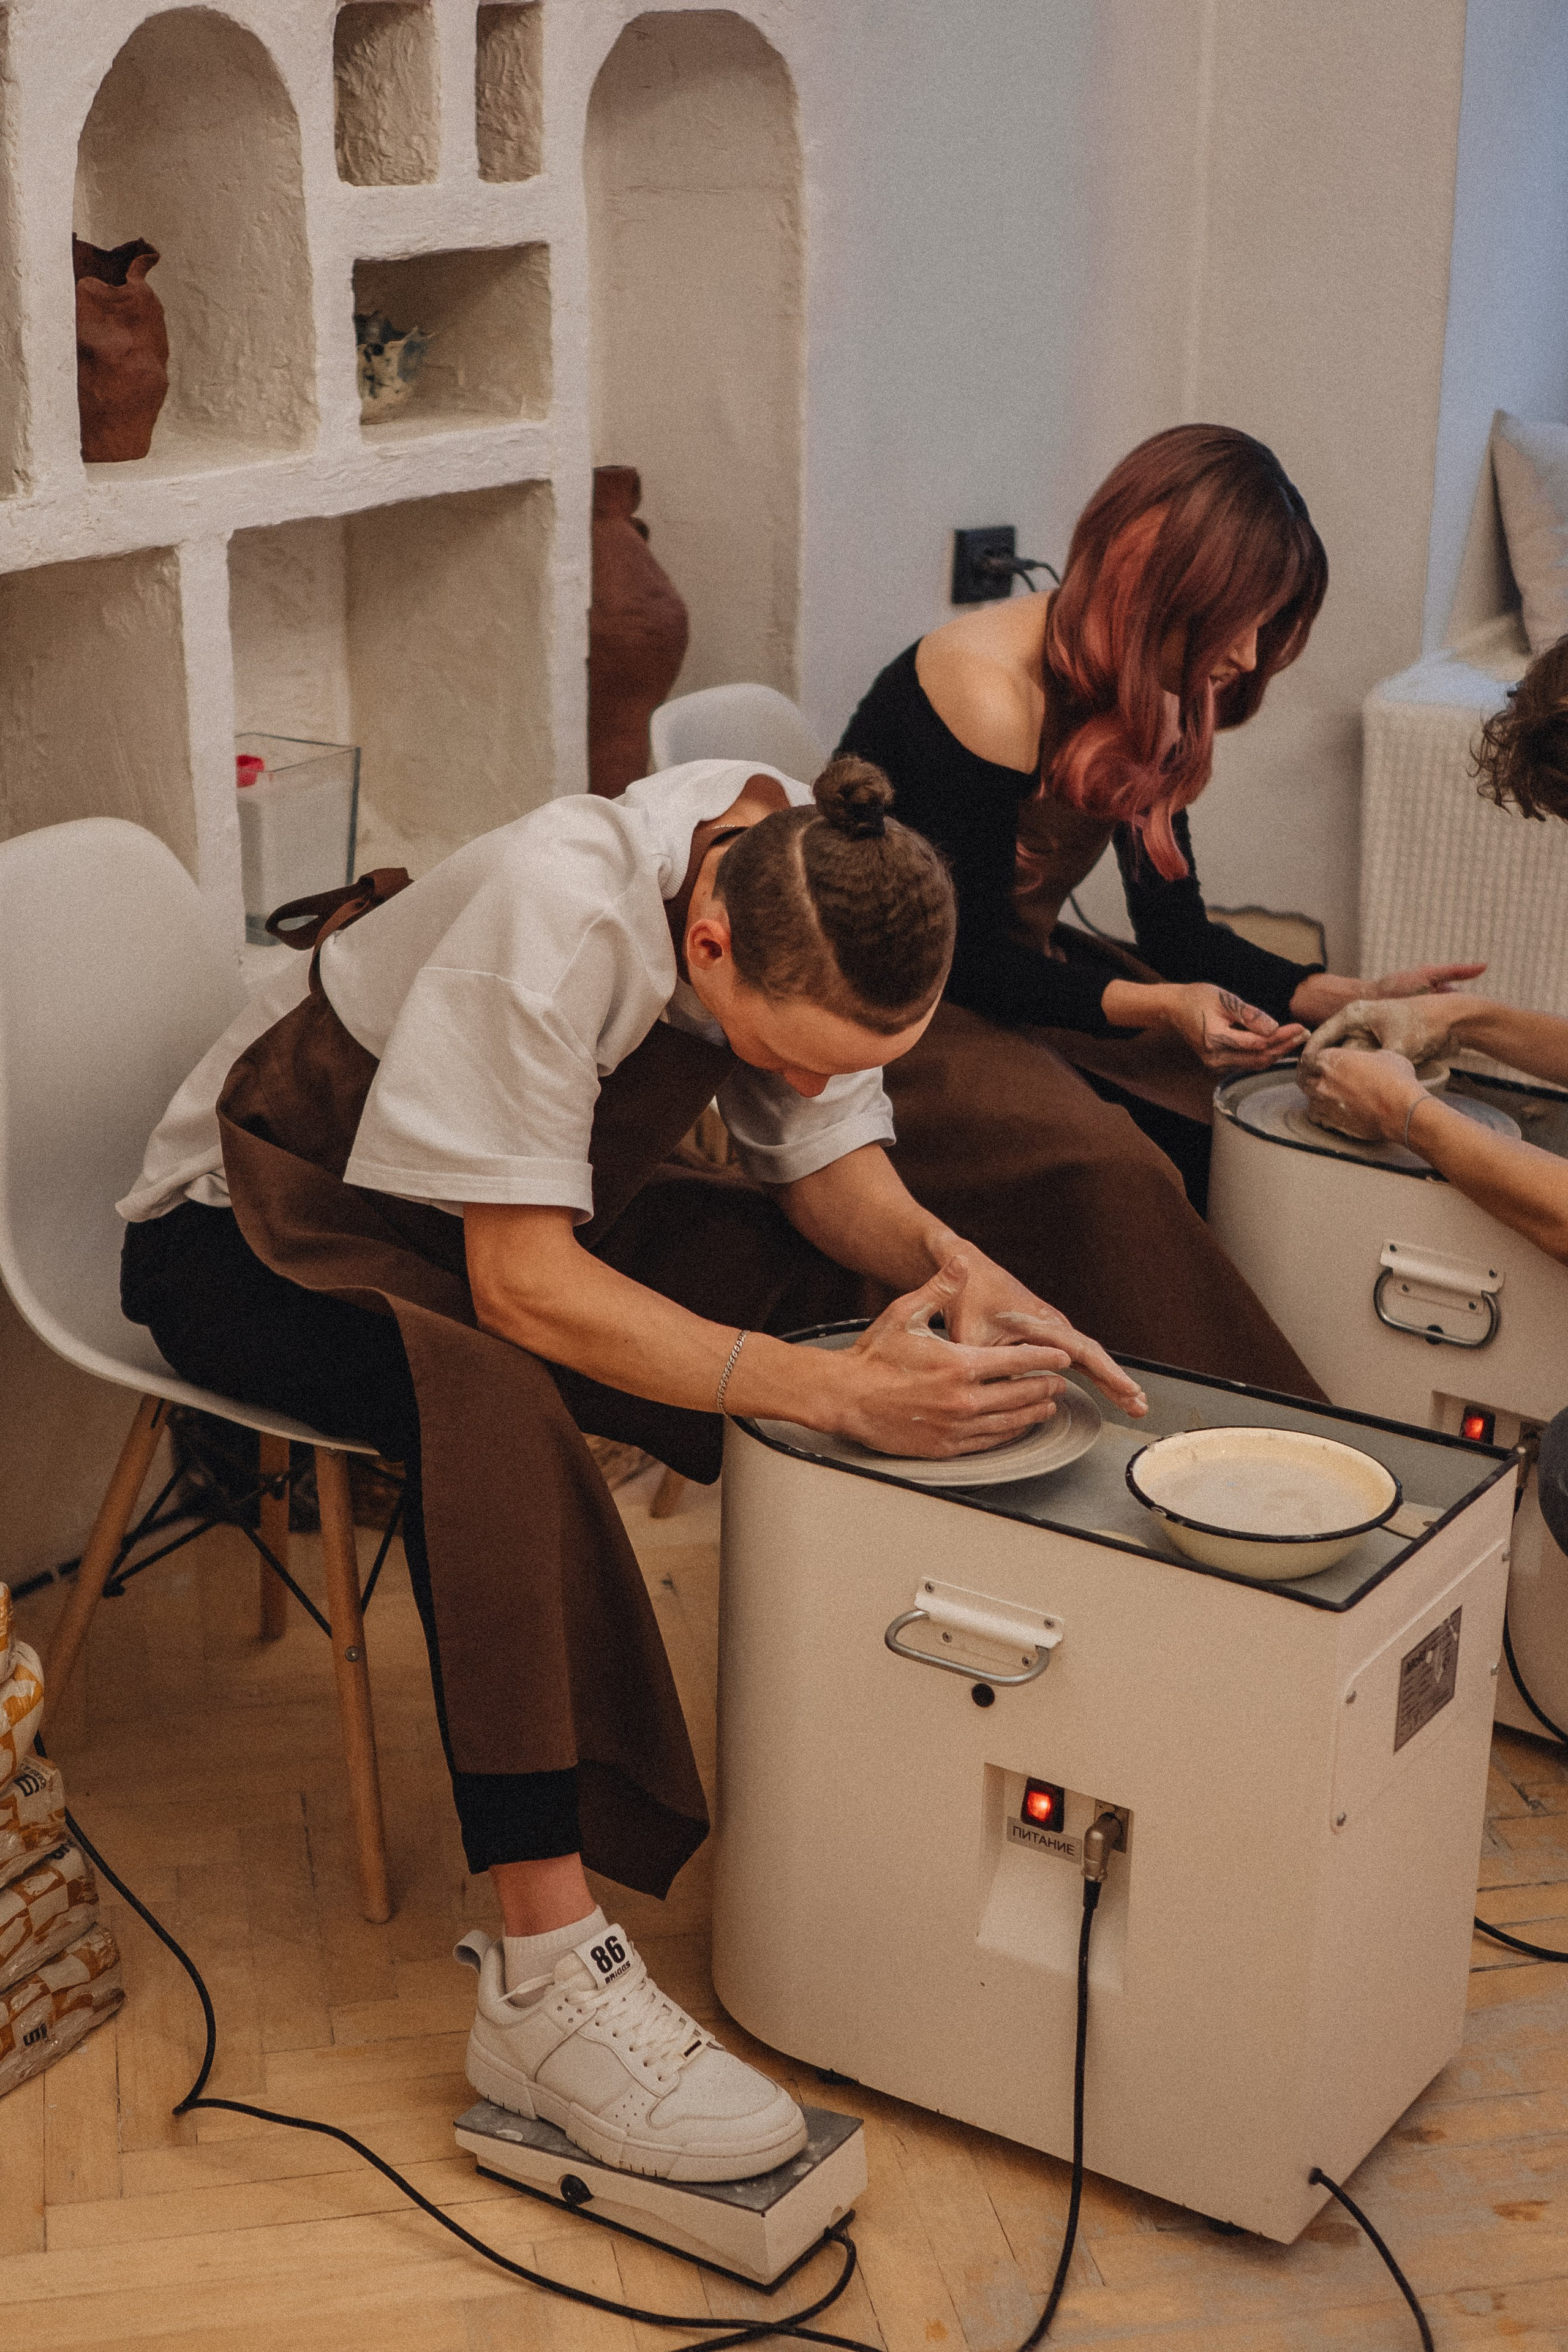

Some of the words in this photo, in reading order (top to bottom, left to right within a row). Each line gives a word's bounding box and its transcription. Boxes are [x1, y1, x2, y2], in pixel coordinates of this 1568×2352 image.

[1012, 1825, 1075, 1856] ПИТАНИЕ
[590, 1935, 626, 1974] 86
[604, 1960, 631, 1985] BRIGGS
